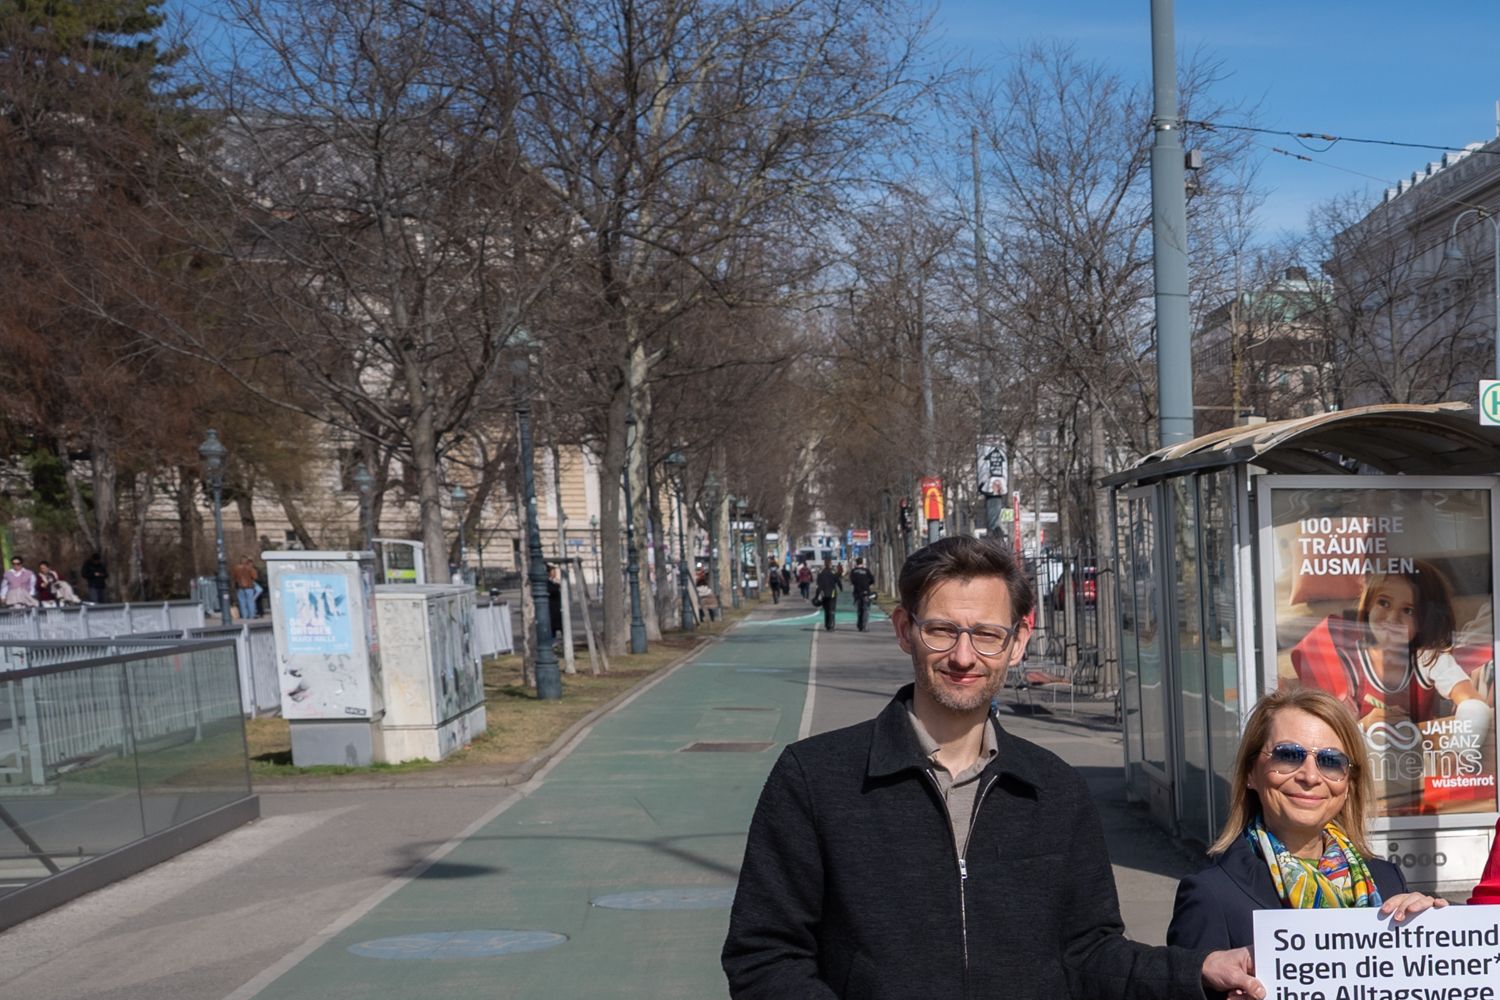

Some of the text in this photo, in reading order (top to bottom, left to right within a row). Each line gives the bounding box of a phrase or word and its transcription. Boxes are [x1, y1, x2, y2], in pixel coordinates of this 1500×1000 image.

[1300, 516, 1404, 534] 100 JAHRE
[1298, 534, 1387, 555] TRÄUME
[1299, 557, 1420, 576] AUSMALEN.
[1422, 720, 1473, 735] JAHRE
[1439, 735, 1480, 749] GANZ
[1274, 929, 1306, 951] So
[1275, 957, 1347, 985] legen
[1355, 955, 1394, 978] die
